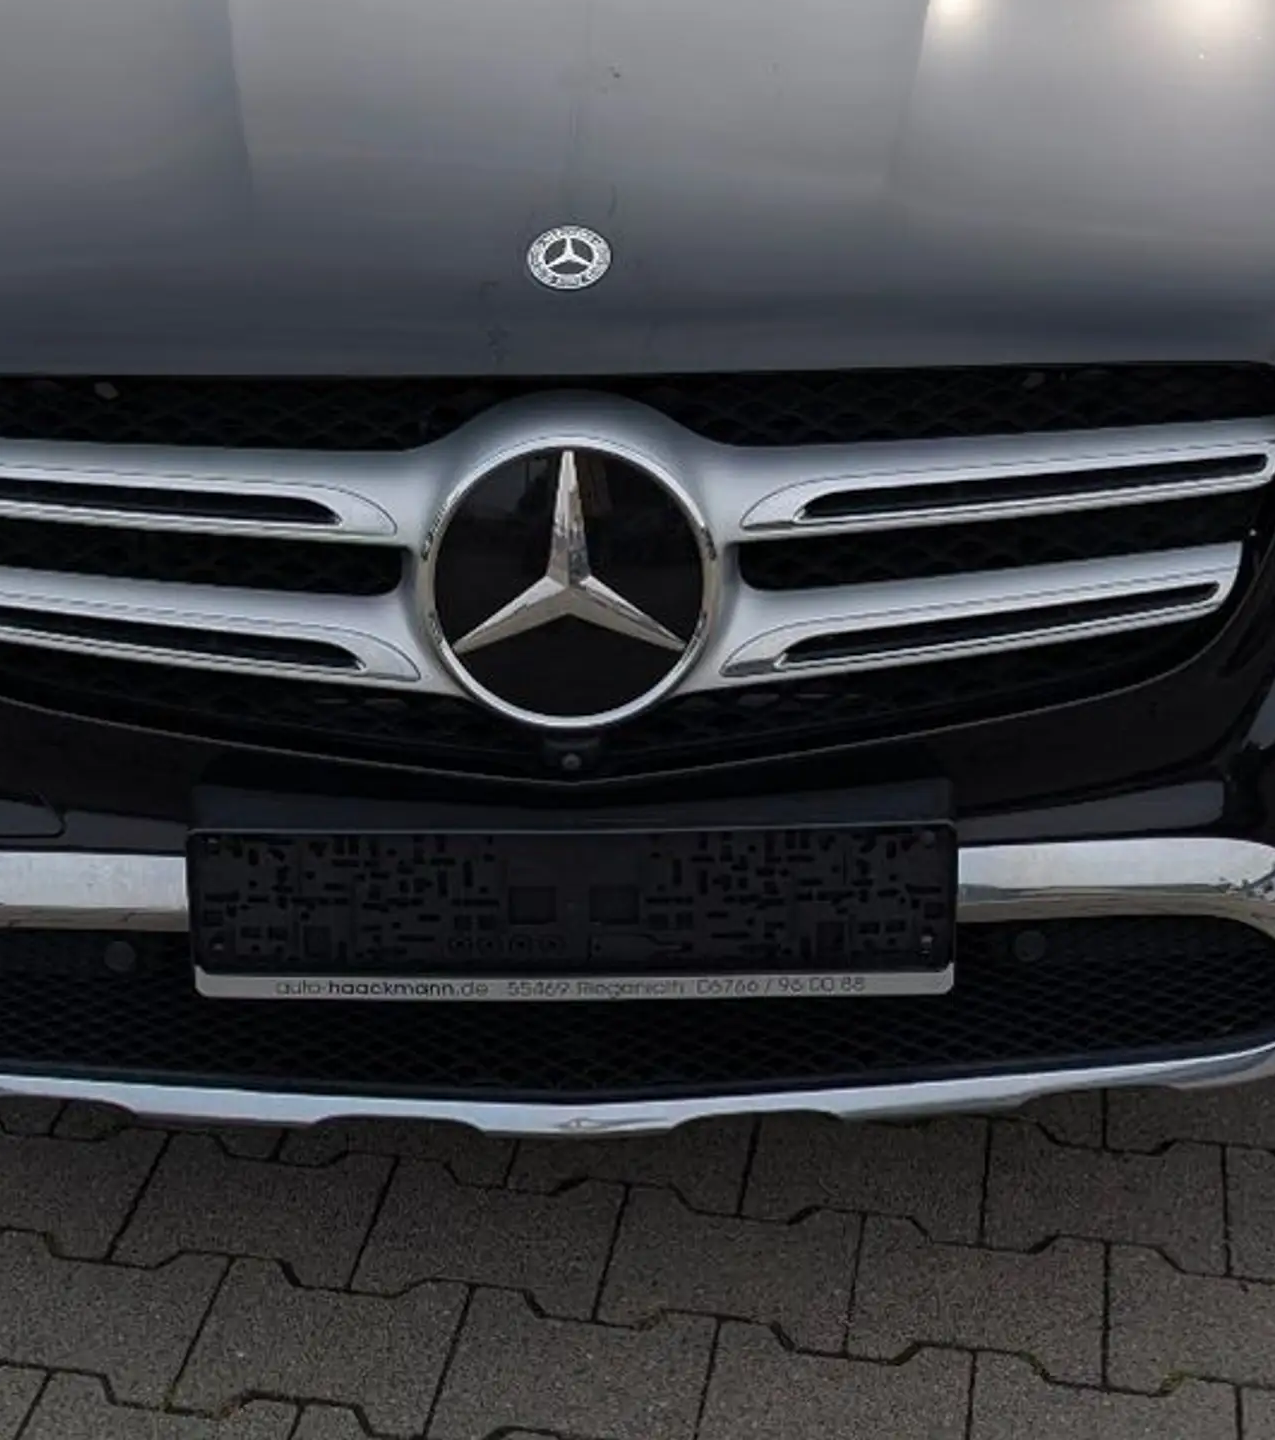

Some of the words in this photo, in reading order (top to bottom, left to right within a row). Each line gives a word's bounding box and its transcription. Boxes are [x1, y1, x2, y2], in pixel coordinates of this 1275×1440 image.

[275, 979, 490, 997] auto-haackmann.de
[507, 978, 570, 997] 55469
[696, 978, 759, 994] 06766
[777, 977, 804, 993] 96
[840, 975, 867, 992] 88
